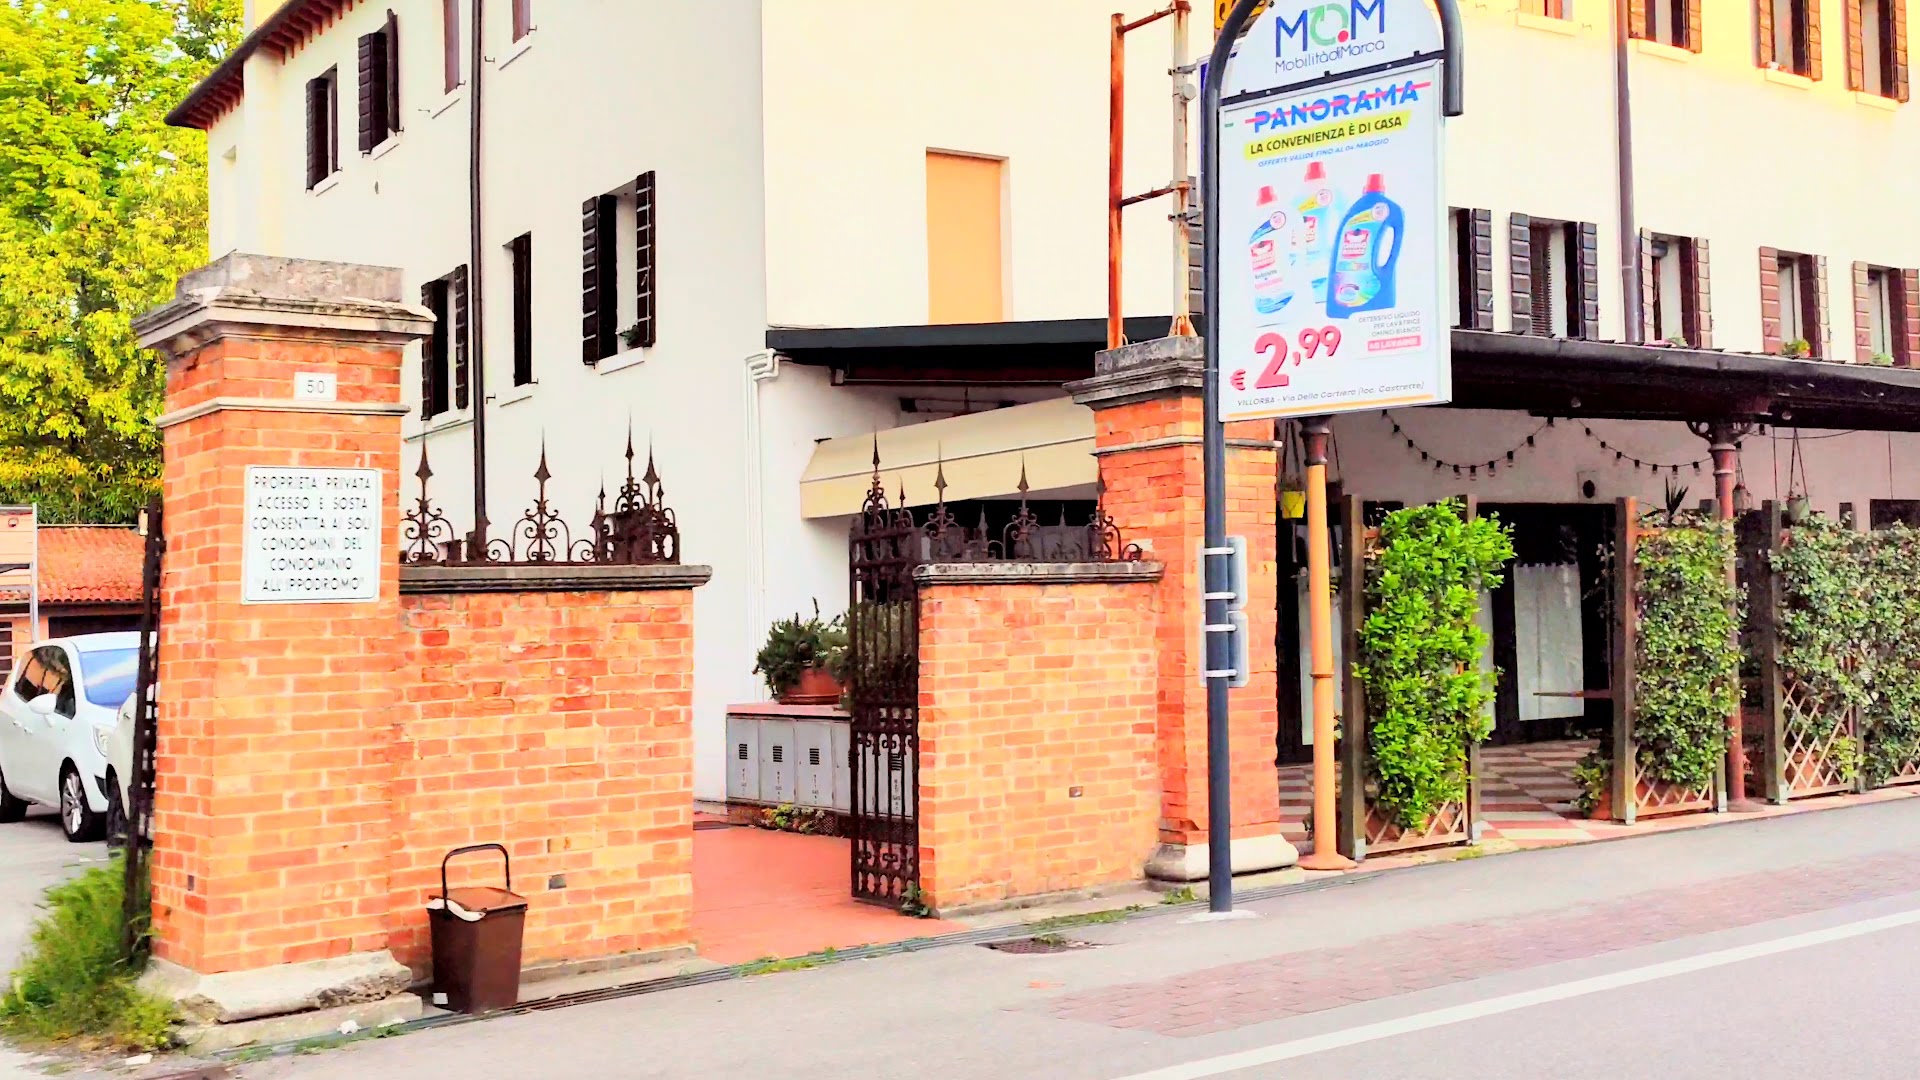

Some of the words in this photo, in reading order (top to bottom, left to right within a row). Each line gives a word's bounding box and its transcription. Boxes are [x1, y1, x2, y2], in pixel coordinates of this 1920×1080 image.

[1253, 80, 1419, 133] PANORAMA
[1250, 143, 1264, 155] LA
[1266, 127, 1345, 150] CONVENIENZA
[1348, 123, 1356, 136] È
[1358, 122, 1371, 134] DI
[1374, 116, 1402, 130] CASA
[1258, 157, 1288, 167] OFFERTE
[1290, 152, 1314, 162] VALIDE
[1315, 149, 1334, 157] FINO
[1356, 138, 1390, 149] MAGGIO
[306, 379, 325, 393] 50
[326, 477, 371, 490] PRIVATA
[258, 496, 310, 510] ACCESSO
[333, 497, 367, 510] SOSTA
[252, 516, 325, 530] CONSENTITA
[347, 517, 371, 530] SOLI
[261, 537, 335, 551] CONDOMINI
[344, 537, 362, 550] DEL
[270, 557, 353, 571] CONDOMINIO
